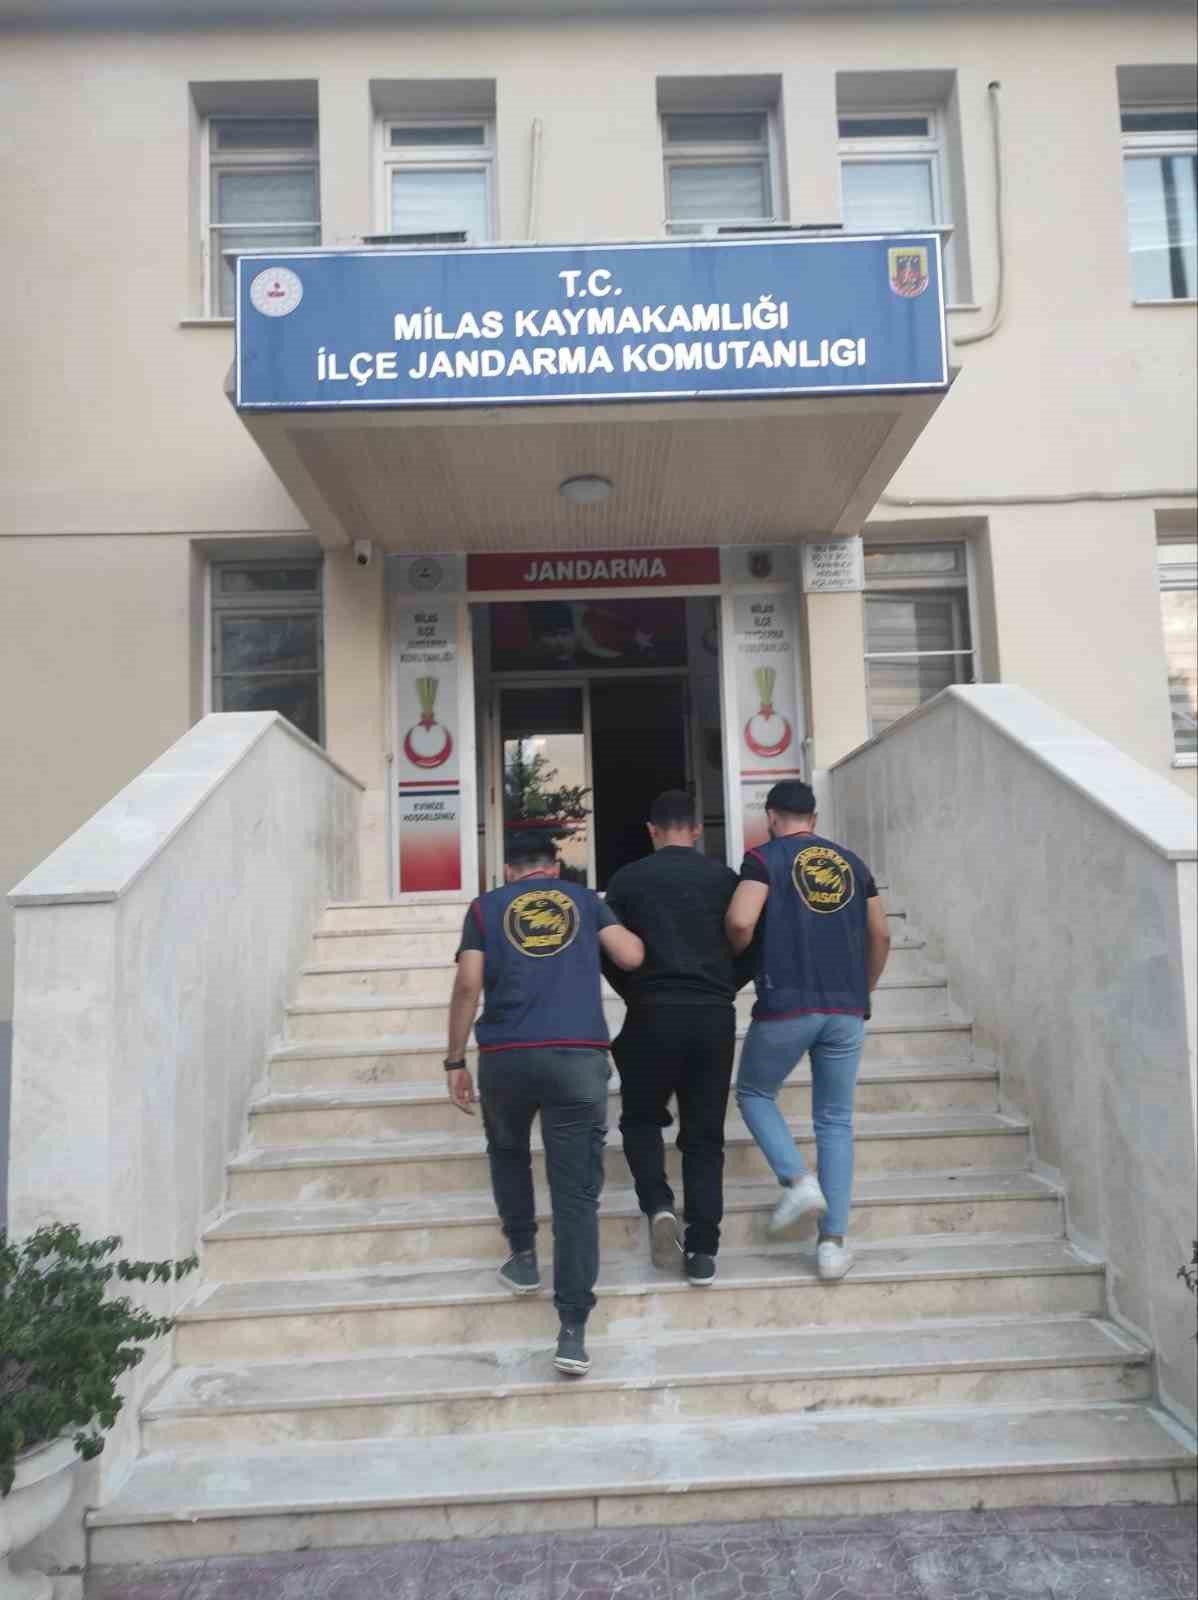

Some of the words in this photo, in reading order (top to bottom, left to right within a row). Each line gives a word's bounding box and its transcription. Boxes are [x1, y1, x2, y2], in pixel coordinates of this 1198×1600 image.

[559, 268, 623, 297] T.C.
[394, 306, 503, 341] MİLAS
[515, 294, 789, 337] KAYMAKAMLIĞI
[317, 346, 398, 386] İLÇE
[408, 345, 615, 379] JANDARMA
[523, 557, 667, 582] JANDARMA
